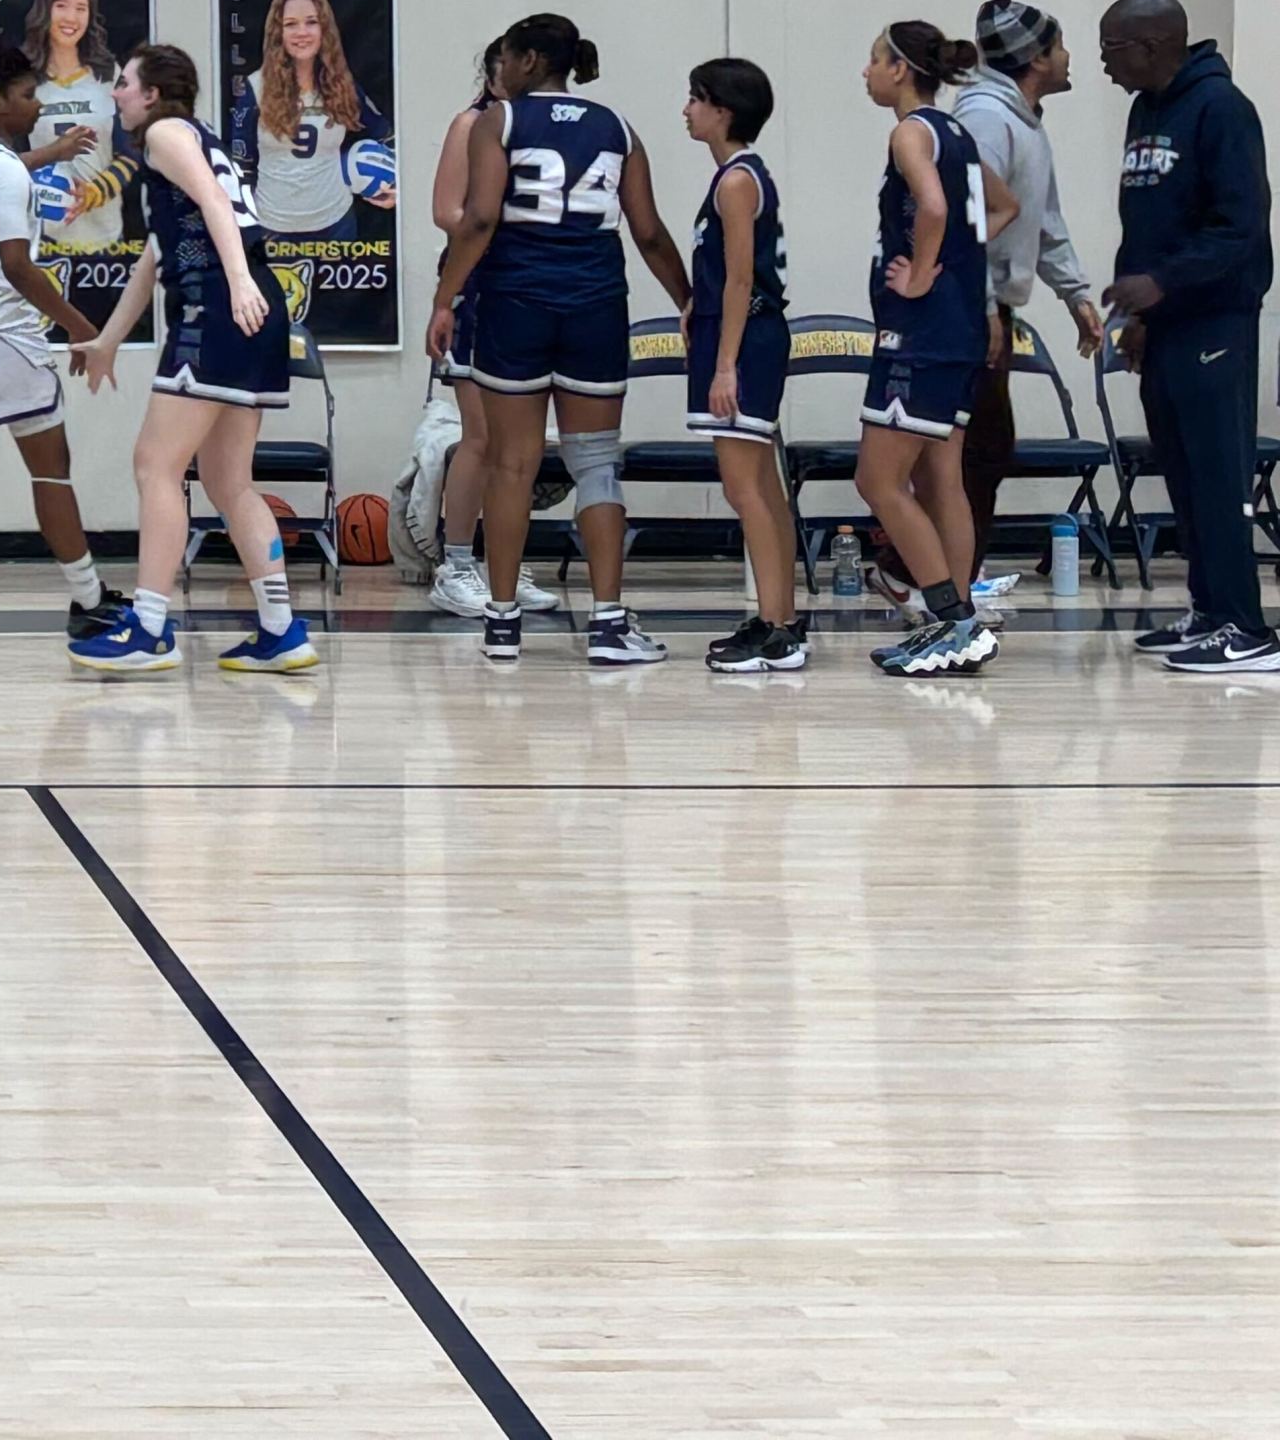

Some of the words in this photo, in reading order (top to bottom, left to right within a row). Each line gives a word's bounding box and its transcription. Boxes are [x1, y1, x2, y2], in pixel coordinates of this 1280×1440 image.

[292, 124, 317, 159] 9
[503, 147, 624, 230] 34
[265, 241, 390, 258] ORNERSTONE
[319, 264, 387, 289] 2025
